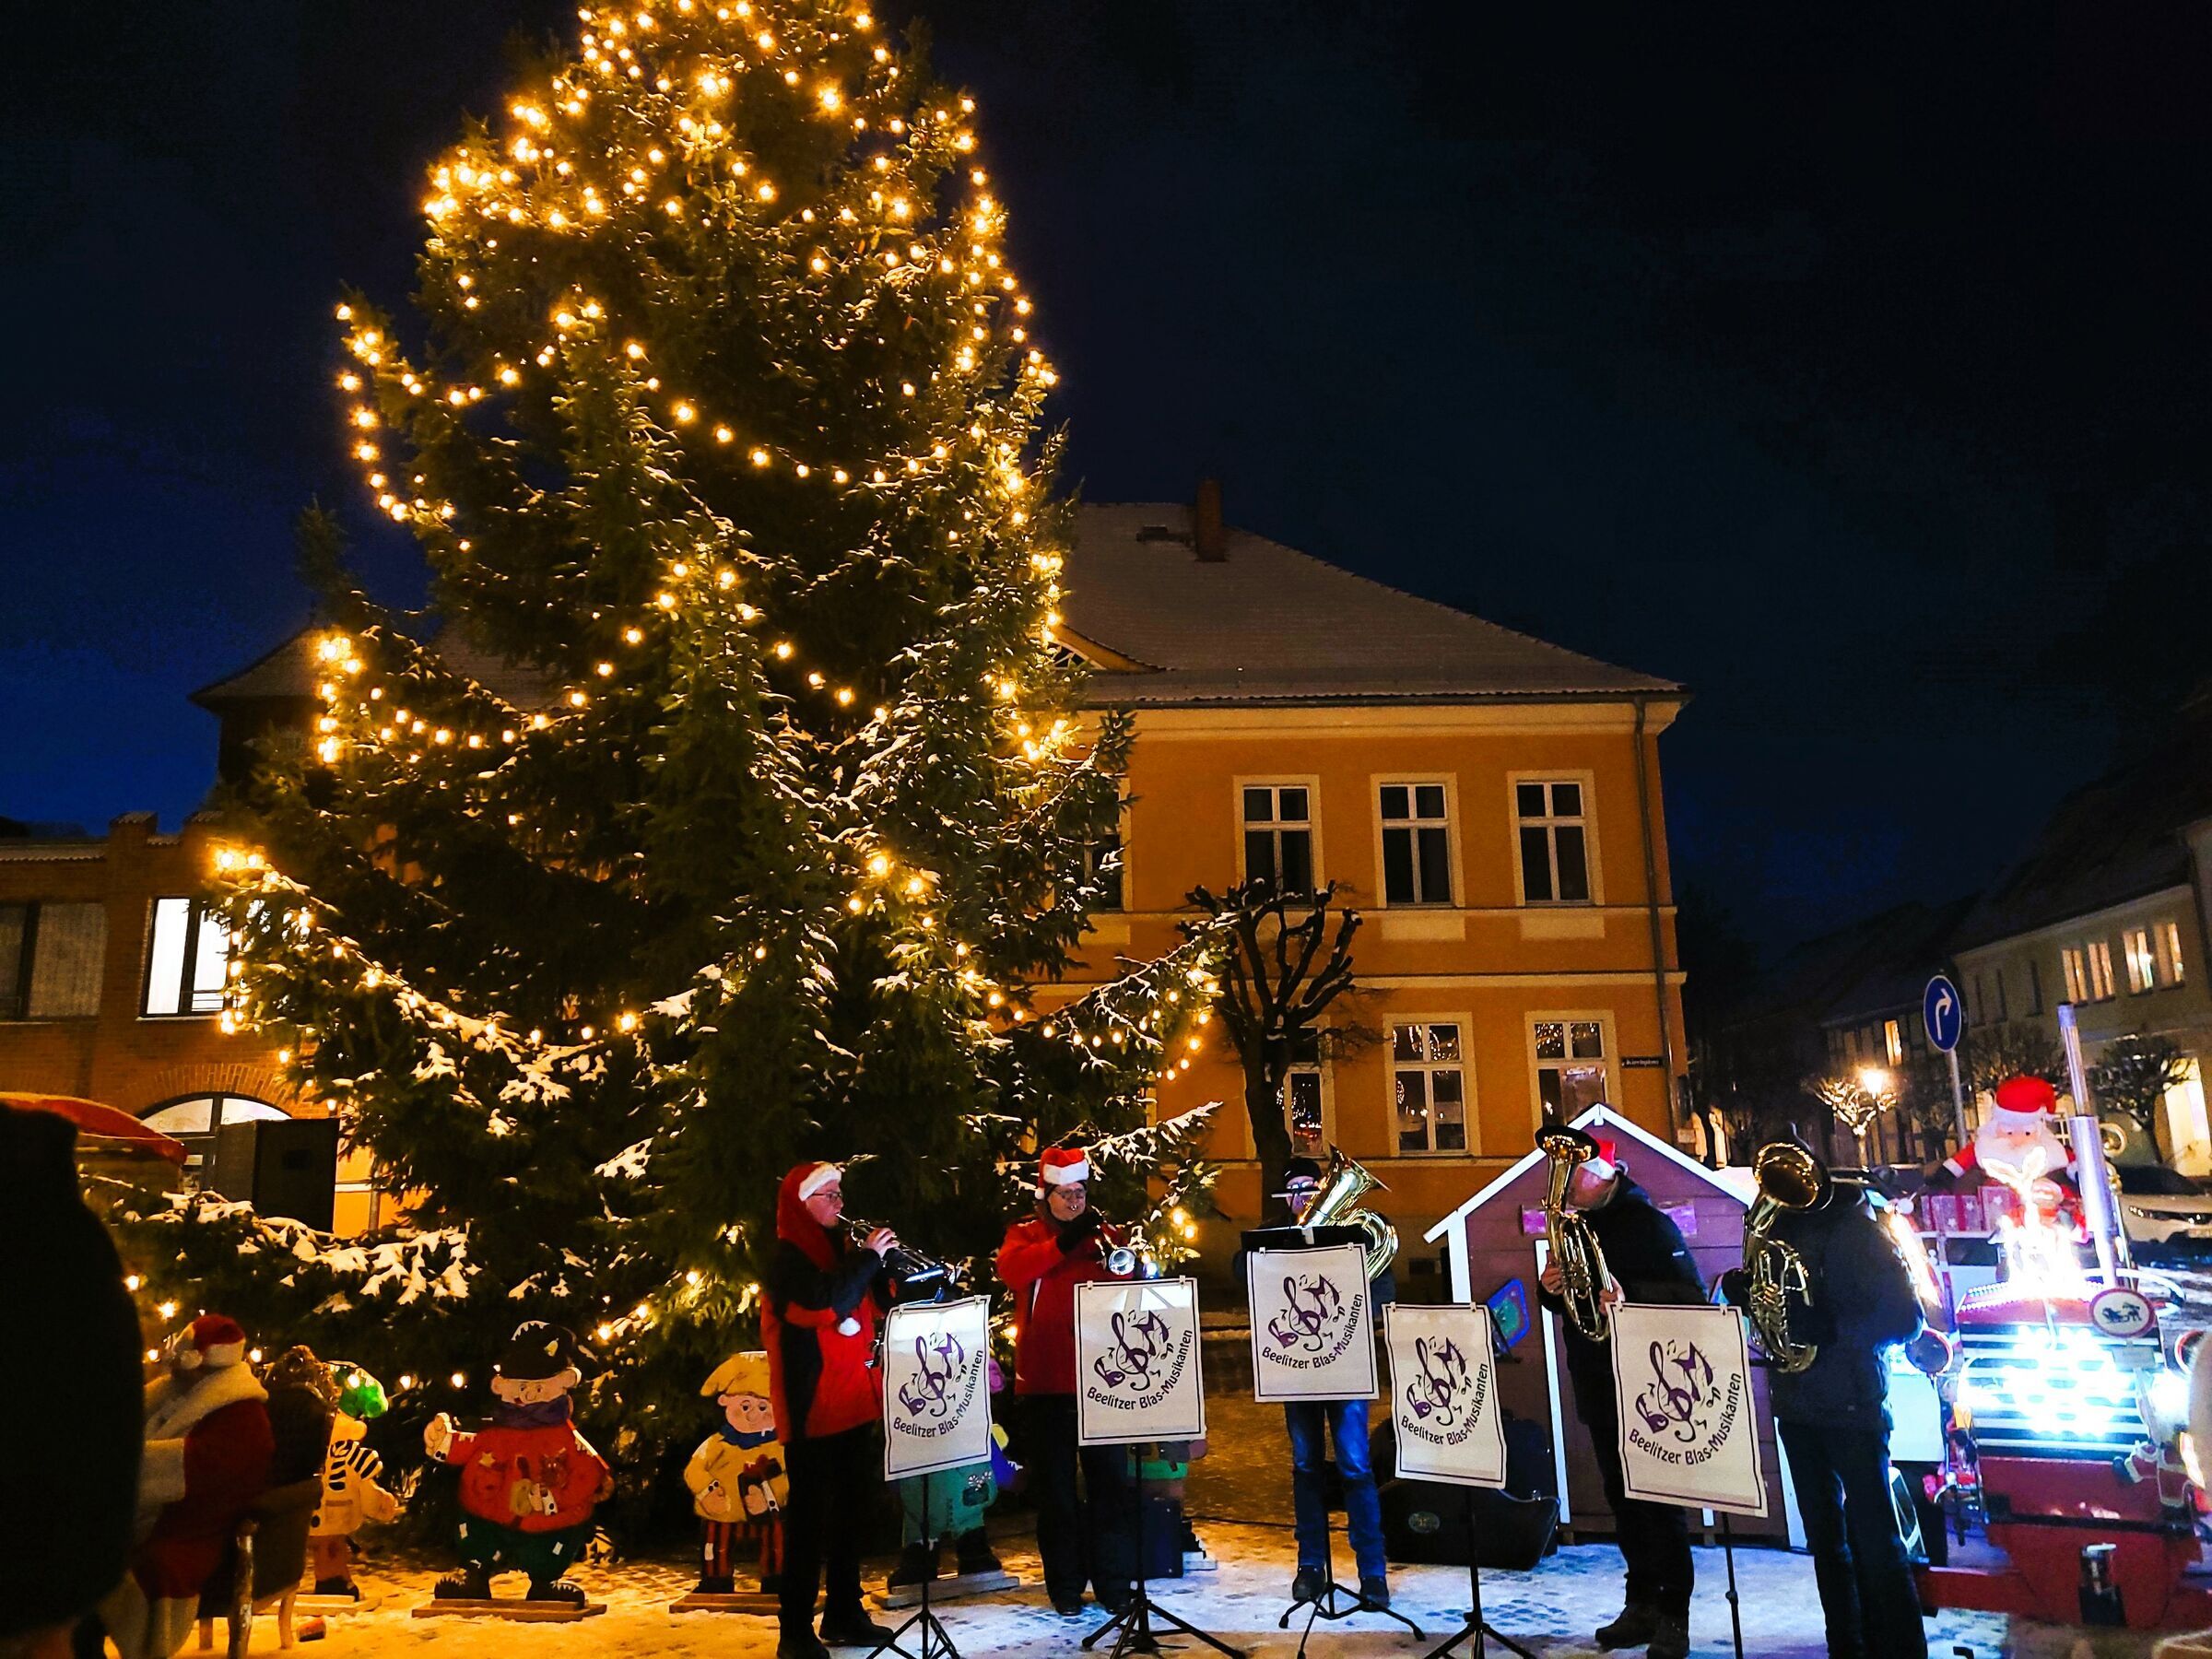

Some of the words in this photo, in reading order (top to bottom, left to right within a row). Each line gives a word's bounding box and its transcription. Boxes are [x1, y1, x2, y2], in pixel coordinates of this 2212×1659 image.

[1088, 1386, 1136, 1410] Beelitzer
[1139, 1330, 1193, 1409] Blas-Musikanten
[1263, 1347, 1310, 1369] Beelitzer
[1312, 1294, 1363, 1369] Blas-Musikanten
[893, 1417, 937, 1438] Beelitzer
[939, 1350, 983, 1435] Blas-Musikanten
[1401, 1415, 1444, 1445] Beelitzer
[1447, 1363, 1488, 1445] Blas-Musikanten
[1629, 1429, 1682, 1465] Beelitzer
[1685, 1373, 1742, 1465] Blas-Musikanten
